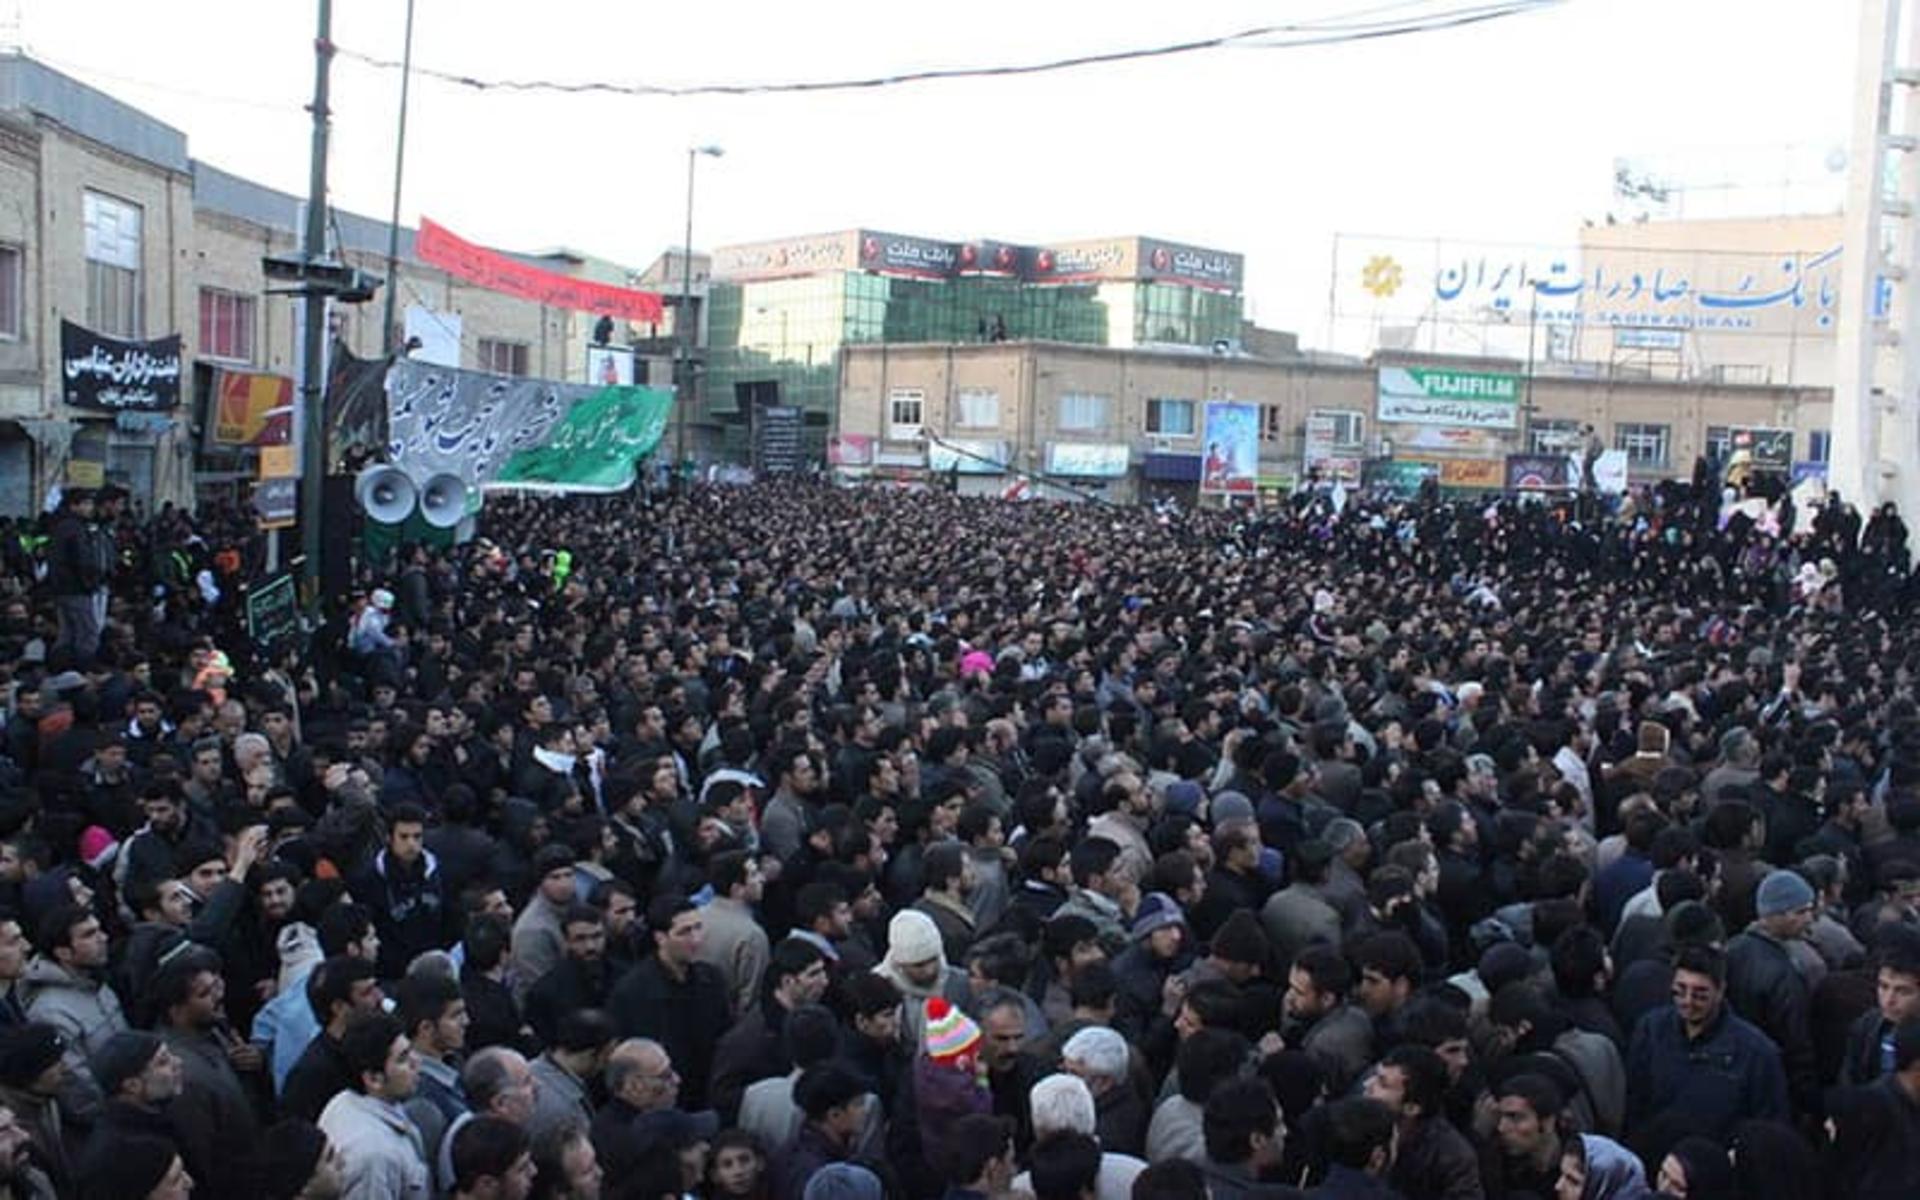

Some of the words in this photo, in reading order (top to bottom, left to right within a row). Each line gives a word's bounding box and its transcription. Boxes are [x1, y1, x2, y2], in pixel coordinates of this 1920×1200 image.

[887, 241, 920, 258] ملت
[922, 248, 955, 269] بانک
[1174, 251, 1204, 270] ملت
[1204, 255, 1232, 275] بانک
[1436, 258, 1526, 308] ایران
[1535, 262, 1689, 303] صادرات
[1699, 244, 1842, 326] بانک
[1422, 374, 1515, 397] FUJIFILM
